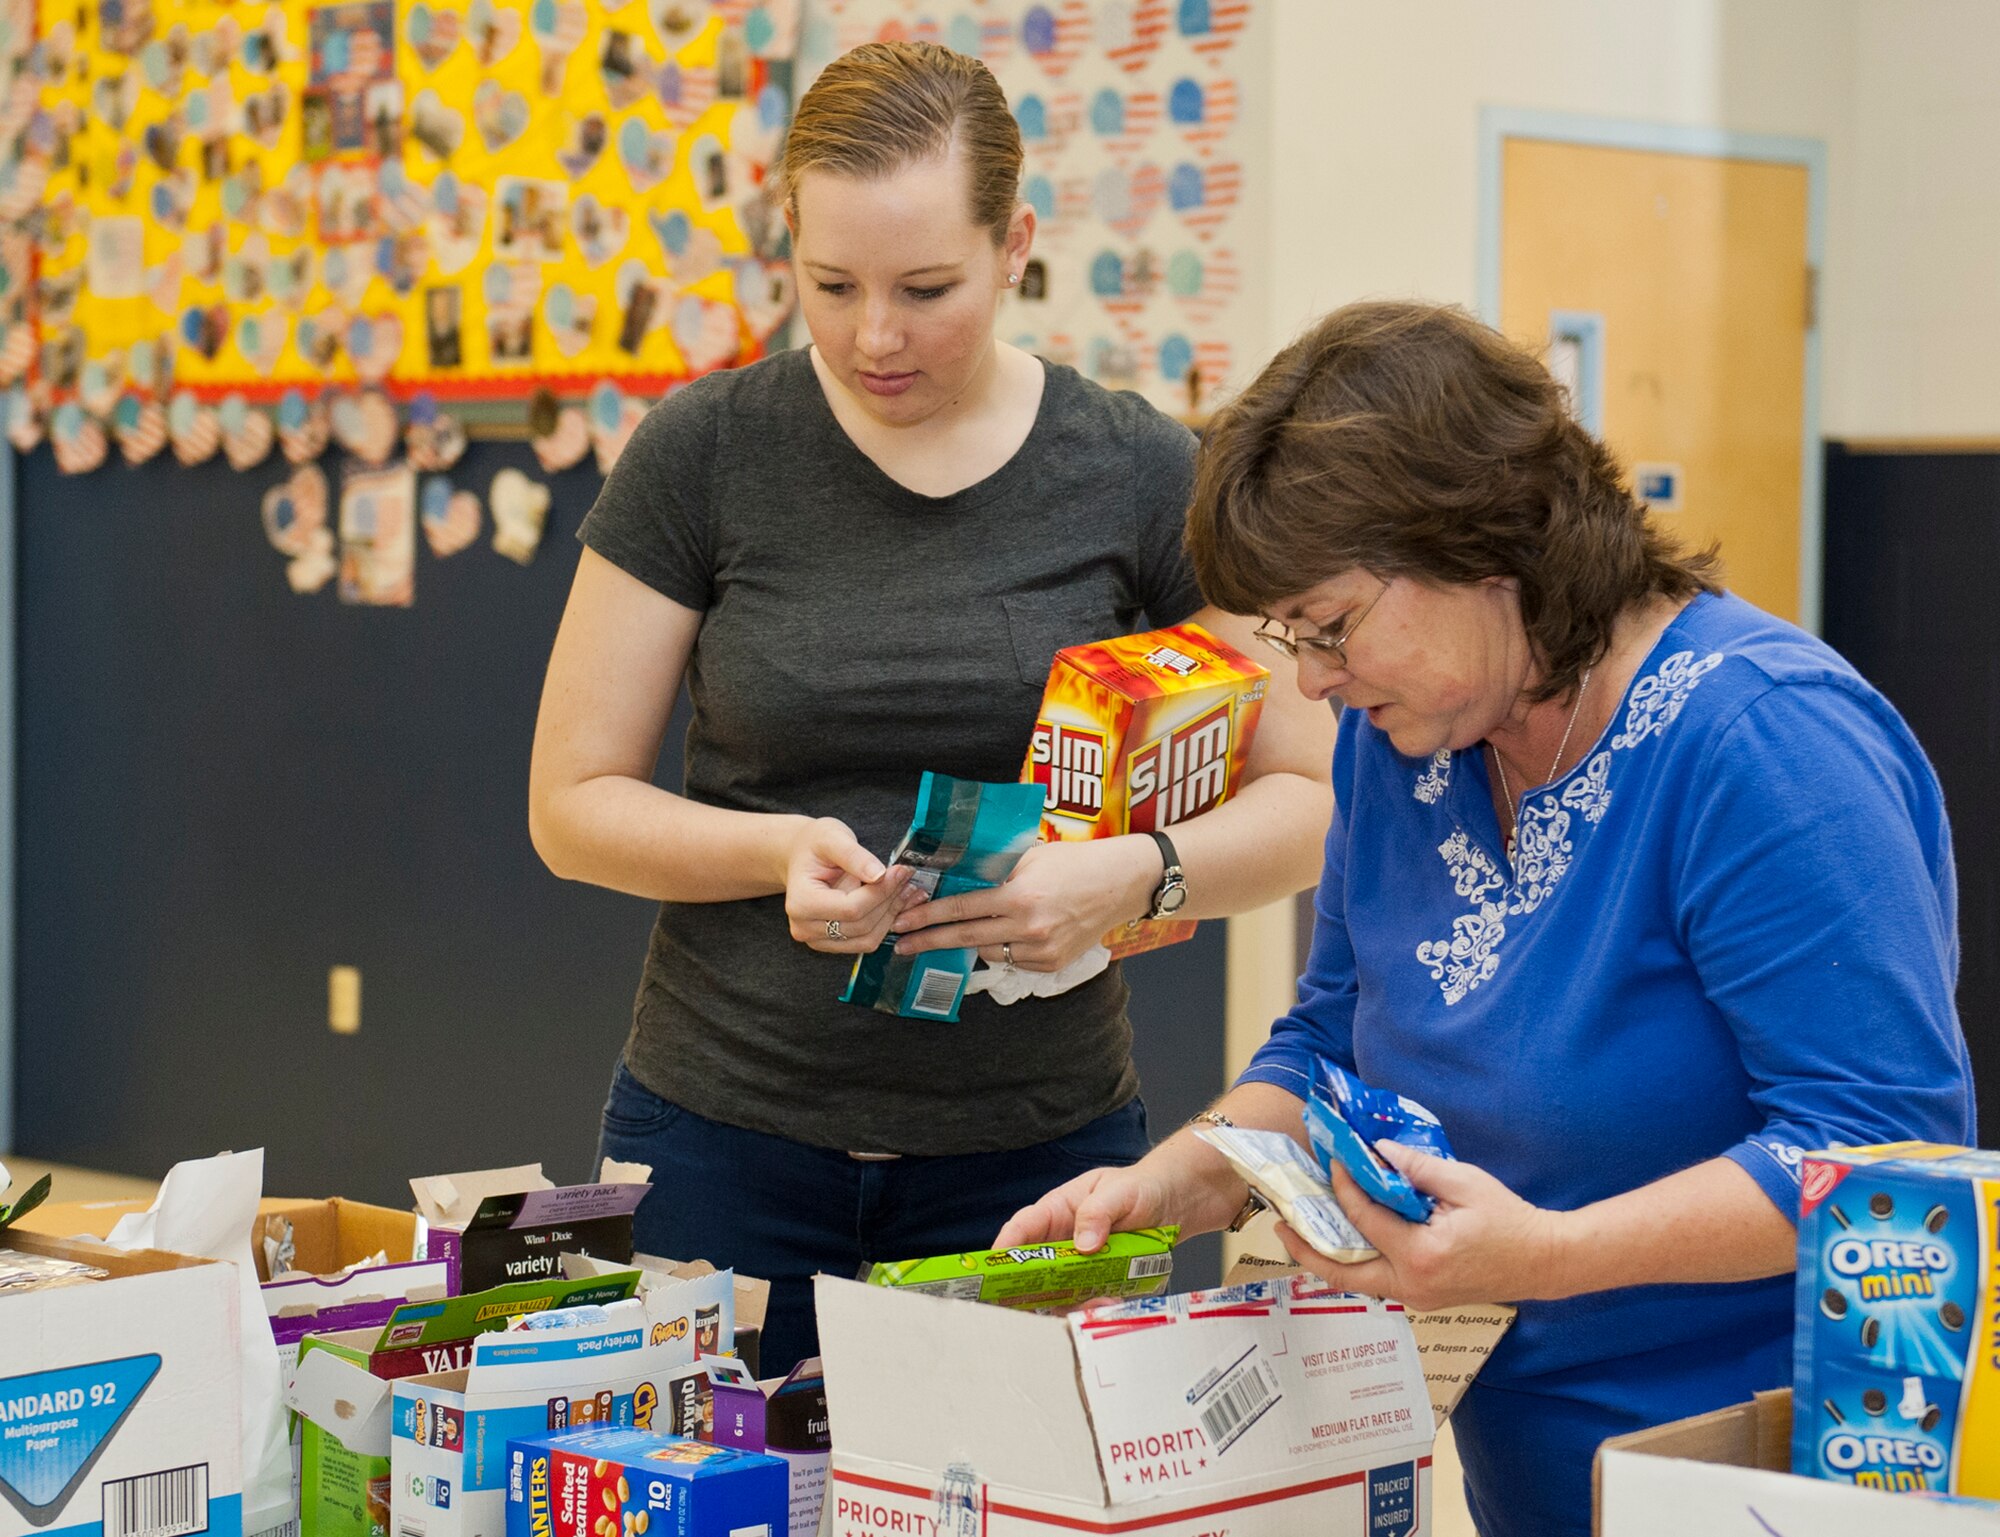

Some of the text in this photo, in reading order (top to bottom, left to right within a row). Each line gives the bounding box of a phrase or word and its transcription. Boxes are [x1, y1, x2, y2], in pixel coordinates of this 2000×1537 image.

[555, 1186, 618, 1200] variety pack
[524, 1231, 573, 1246] Winn Dixie
[505, 1257, 554, 1277] variety
[1832, 1239, 1949, 1276] OREO
[567, 1295, 584, 1304] Oats
[595, 1289, 619, 1301] Honey
[1861, 1268, 1934, 1300] mini
[478, 1297, 553, 1319] NATURE VALLEY
[695, 1312, 719, 1328] QUAKER
[1454, 1315, 1502, 1326] Priority
[577, 1333, 640, 1352] Variety Pack
[650, 1316, 689, 1347] Chewy
[422, 1346, 471, 1374] VAL
[1301, 1353, 1325, 1368] VISIT
[1326, 1350, 1339, 1364] US
[1341, 1348, 1351, 1361] AT
[1432, 1343, 1467, 1354] using
[1470, 1345, 1490, 1355] for
[1304, 1354, 1399, 1379] ORDER FREE SUPPLIES ONLINE
[1424, 1373, 1462, 1384] Priori
[89, 1382, 116, 1407] 92
[415, 1397, 427, 1446] Chewy
[681, 1379, 696, 1440] QUAKE
[4, 1418, 79, 1440] Multipurpose
[436, 1406, 444, 1447] QUAKER
[1311, 1407, 1412, 1439] MEDIUM FLAT RATE BOX
[26, 1436, 60, 1451] Paper
[1303, 1439, 1337, 1453] DOMESTIC
[1338, 1435, 1352, 1445] AND
[1352, 1426, 1401, 1441] INTERNATIONAL
[1401, 1422, 1414, 1432] USE
[1826, 1434, 1943, 1470] OREO
[1139, 1459, 1192, 1485] MAIL
[1855, 1465, 1928, 1493] mini
[561, 1462, 576, 1525] Salted
[648, 1480, 666, 1511] 10
[665, 1483, 673, 1511] PACKS
[1373, 1477, 1408, 1497] TRACKED
[573, 1465, 588, 1537] eanuts
[838, 1497, 941, 1537] PRIORITY
[1374, 1509, 1408, 1529] INSURED
[371, 1525, 384, 1536] 24
